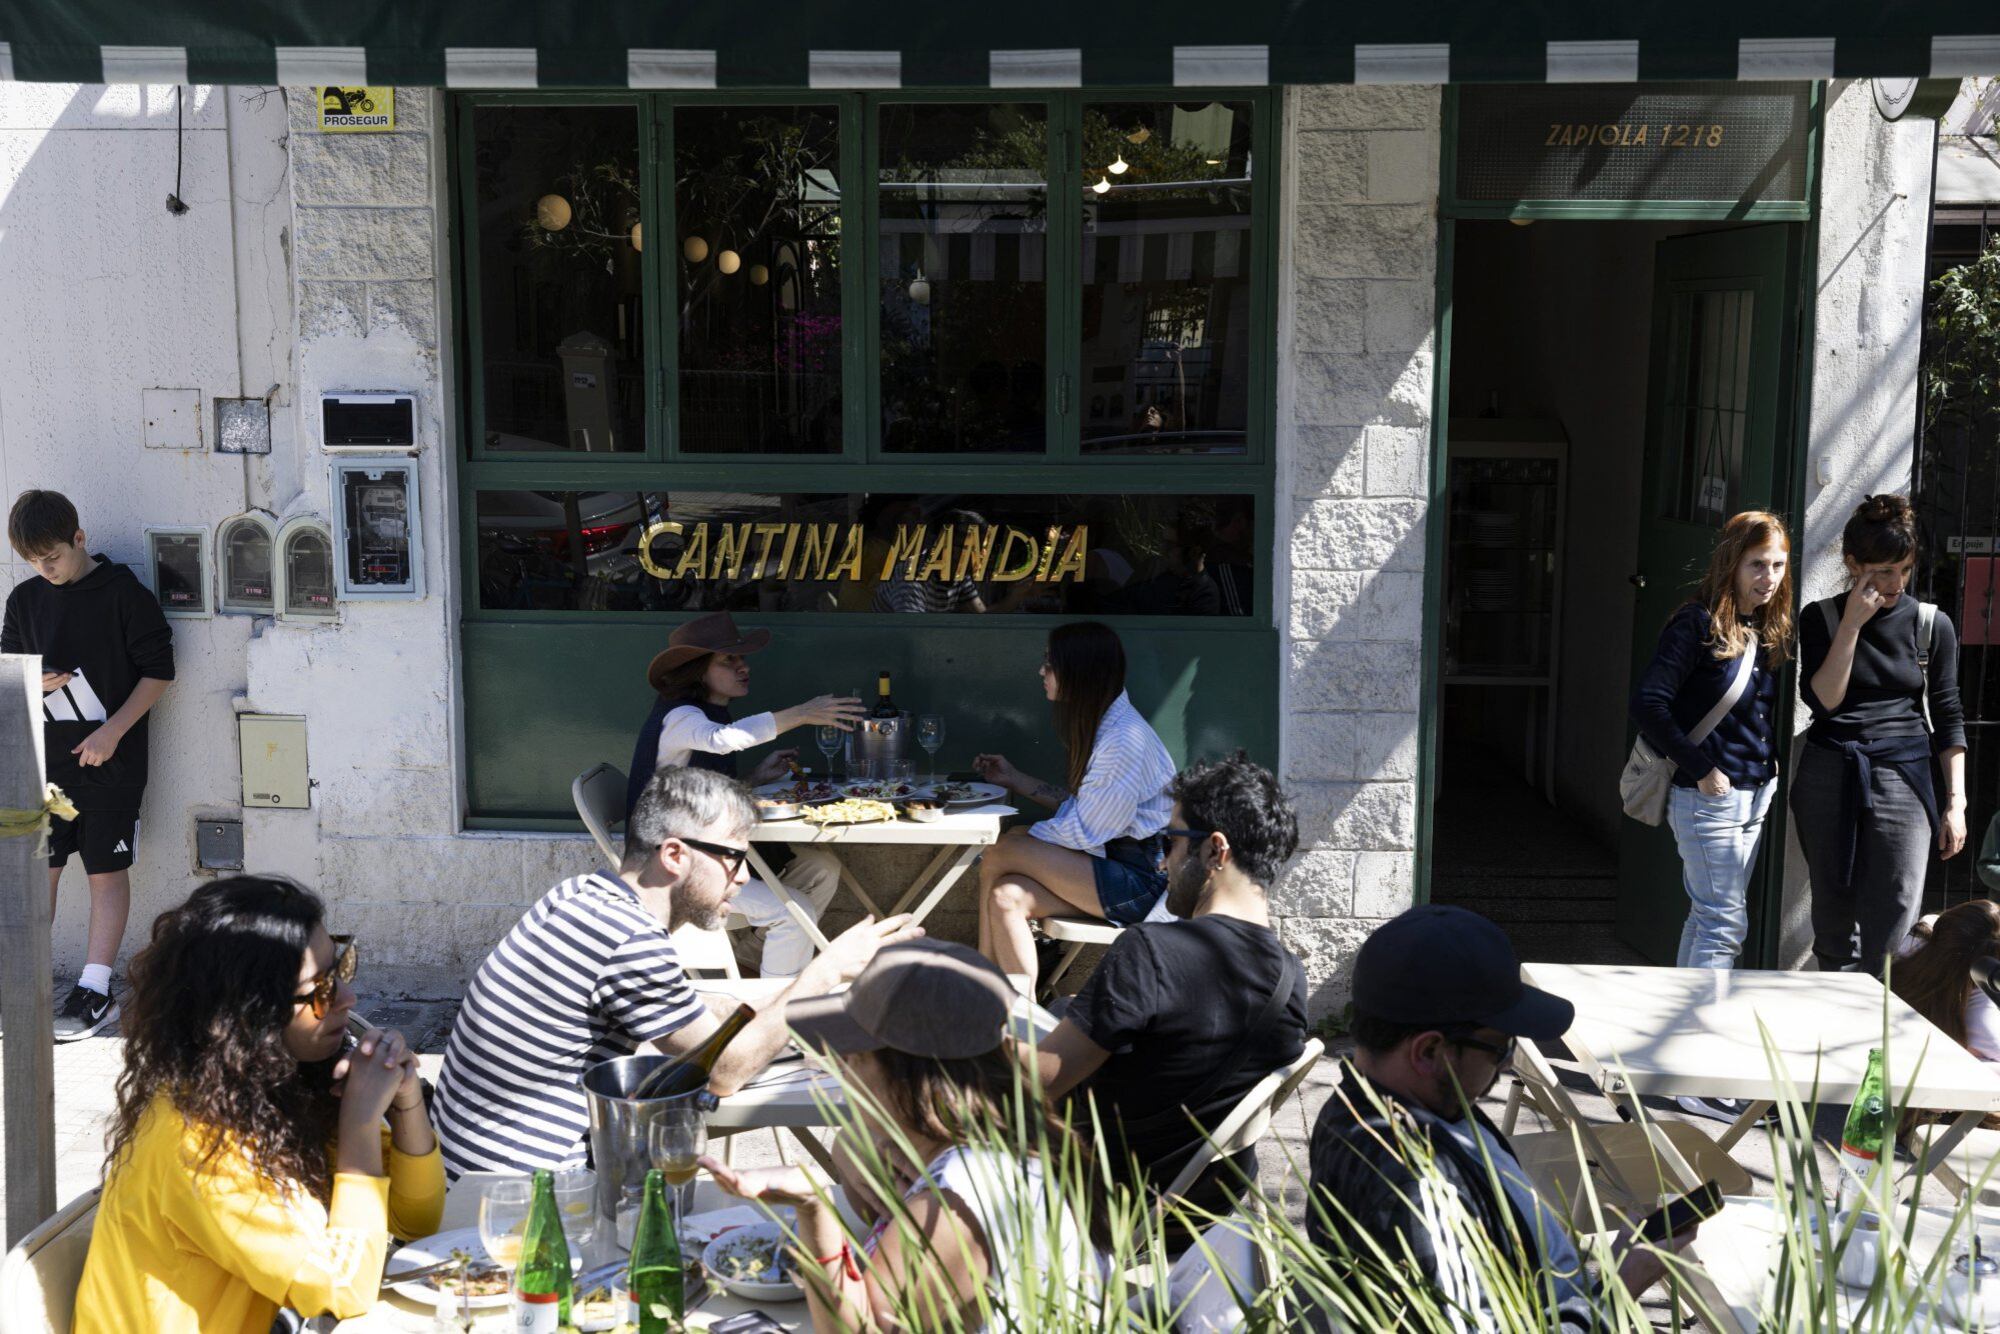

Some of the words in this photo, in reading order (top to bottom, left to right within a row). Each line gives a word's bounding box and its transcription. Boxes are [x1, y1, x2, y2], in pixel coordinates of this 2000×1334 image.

[324, 116, 388, 125] PROSEGUR
[1545, 124, 1648, 146] ZAPIOLA
[1659, 124, 1724, 147] 1218
[638, 521, 865, 580] CANTINA
[880, 524, 1088, 582] MANDIA
